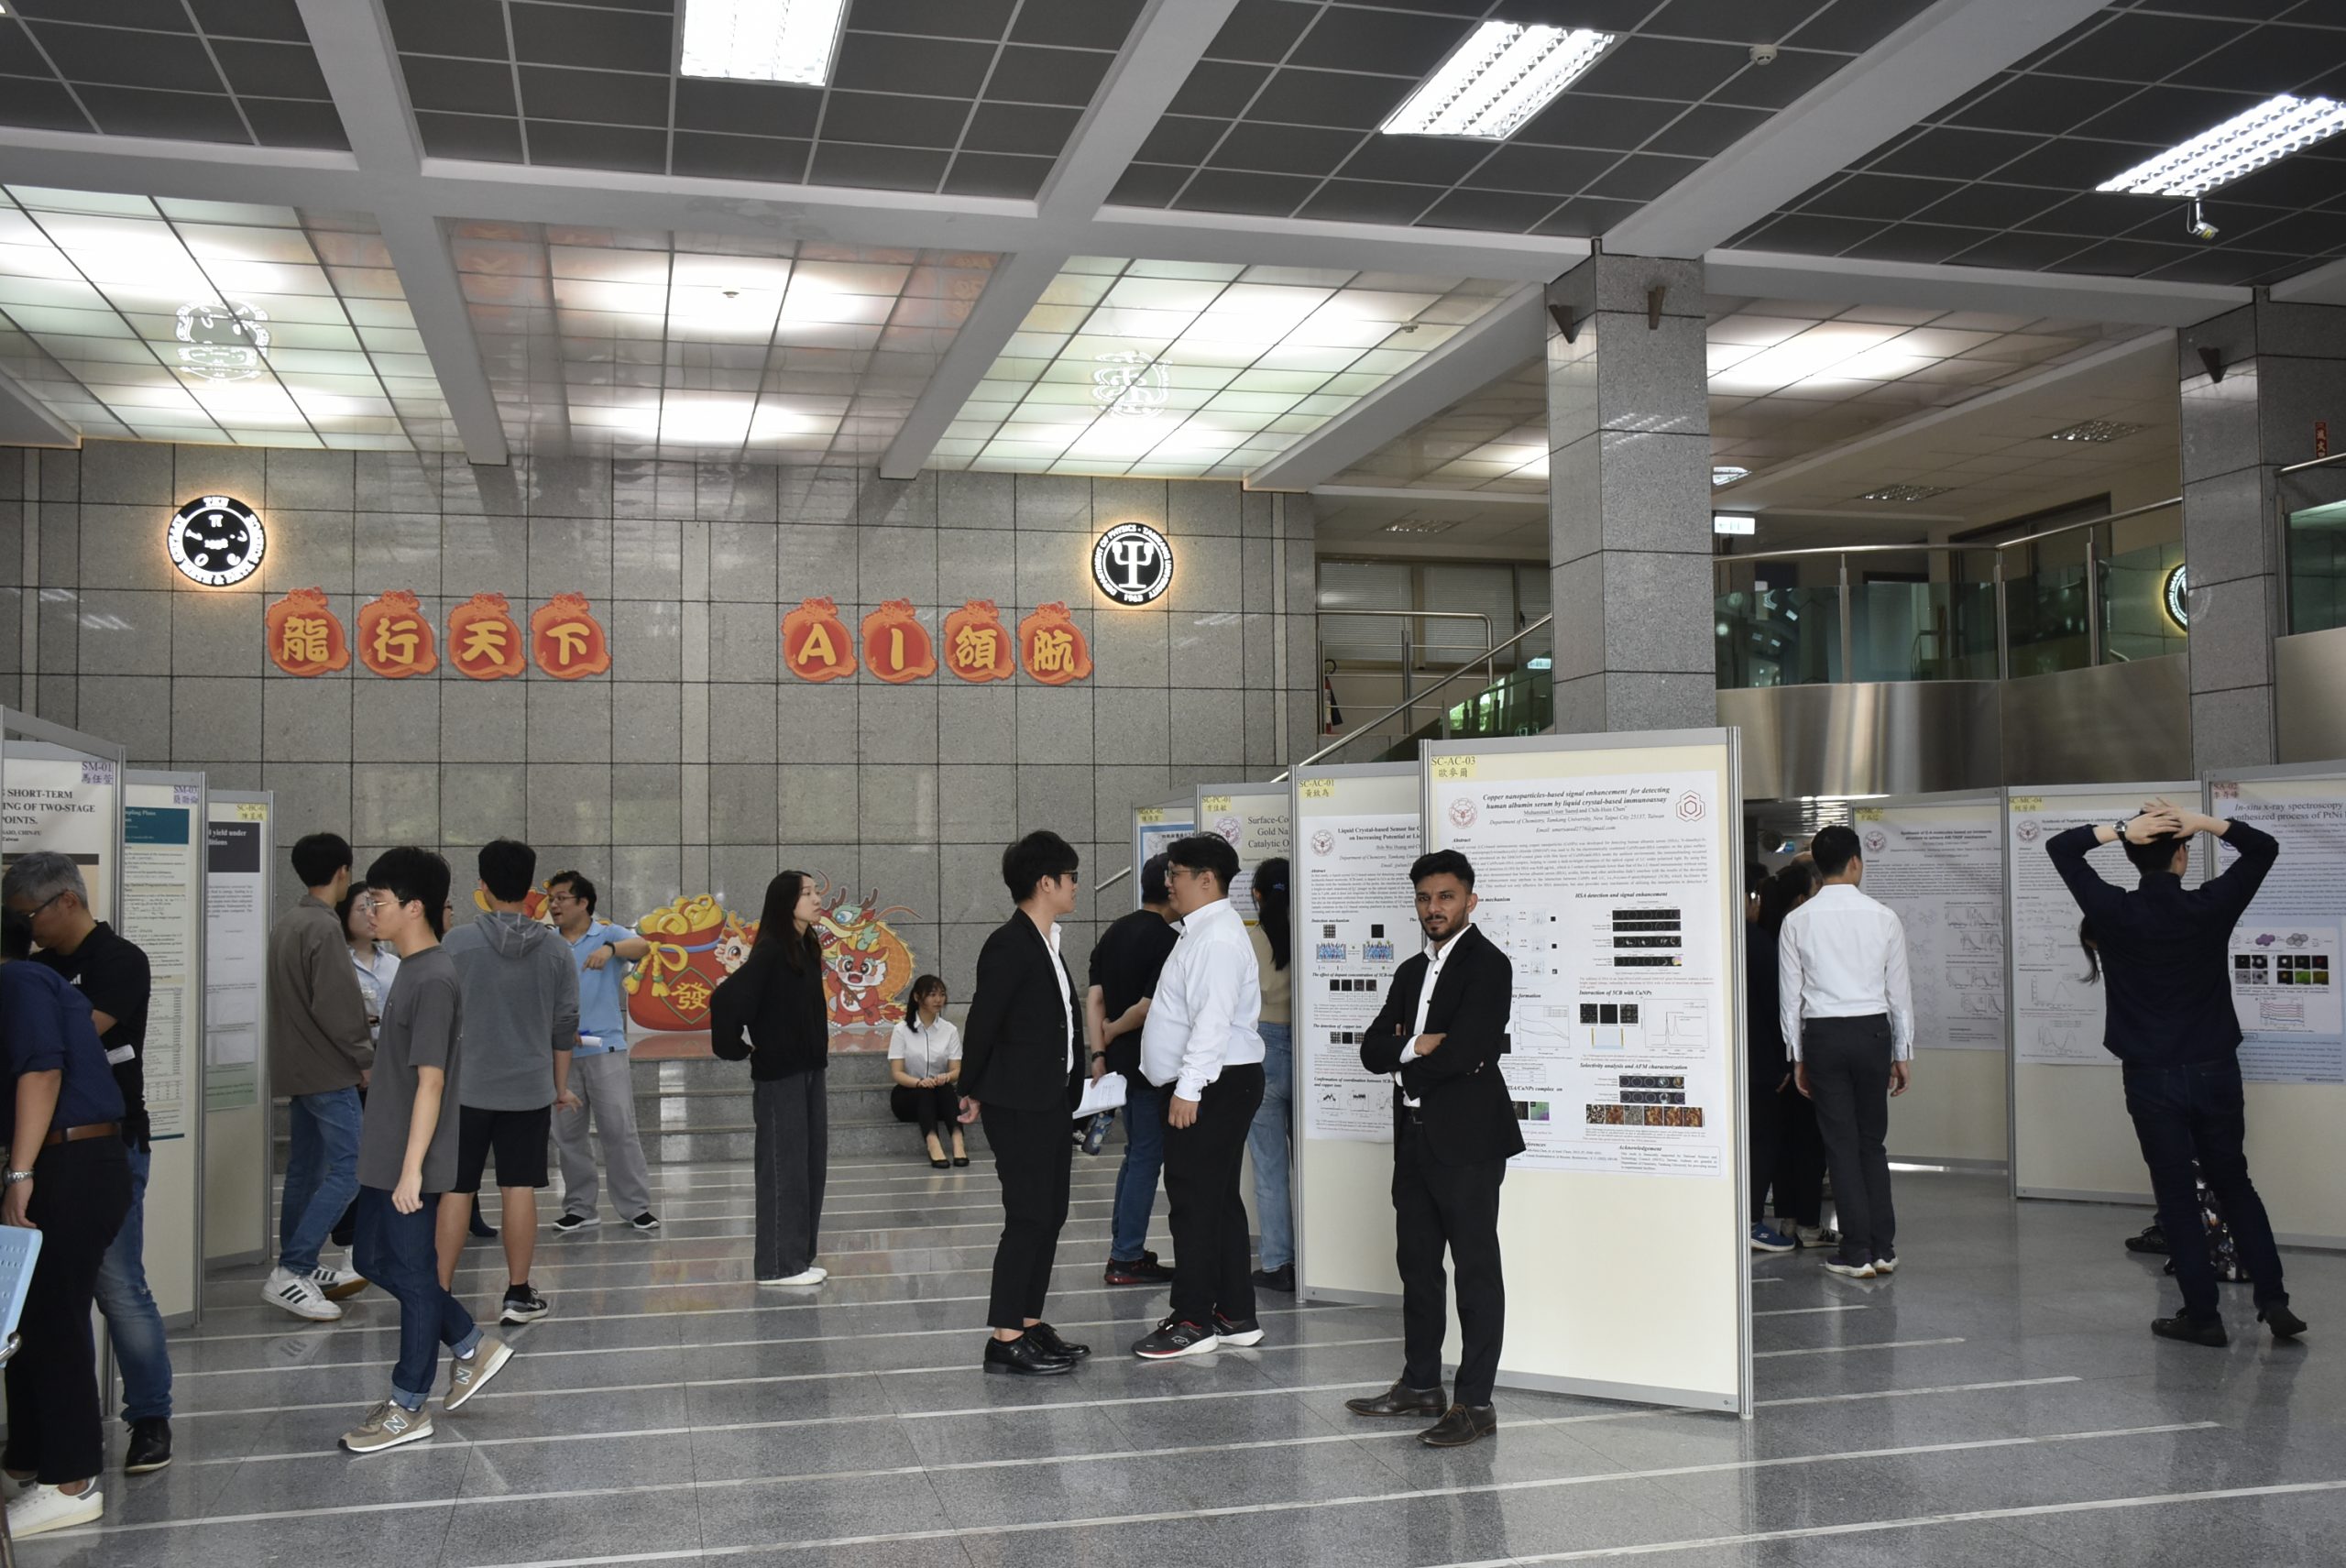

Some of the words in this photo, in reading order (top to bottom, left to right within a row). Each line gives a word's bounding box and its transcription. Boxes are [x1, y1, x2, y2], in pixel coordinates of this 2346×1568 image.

[1431, 756, 1476, 766] SC-AC-03
[82, 762, 112, 772] SM-01
[1299, 779, 1334, 787] SC-AC-01
[7, 789, 72, 799] SHORT-TERM
[1505, 790, 1564, 801] nanoparticles-based
[1565, 790, 1584, 798] signal
[1585, 788, 1628, 796] enhancement
[1629, 787, 1641, 795] for
[1554, 799, 1562, 807] by
[1582, 796, 1622, 806] crystal-based
[23, 803, 38, 811] OF
[39, 804, 95, 813] TWO-STAGE
[2264, 804, 2286, 812] x-ray
[2287, 802, 2343, 811] spectroscopy
[2277, 813, 2309, 821] process
[2311, 811, 2319, 819] of
[1256, 828, 1276, 836] Gold
[1247, 839, 1281, 849] Catalytic
[671, 981, 712, 1011] 發
